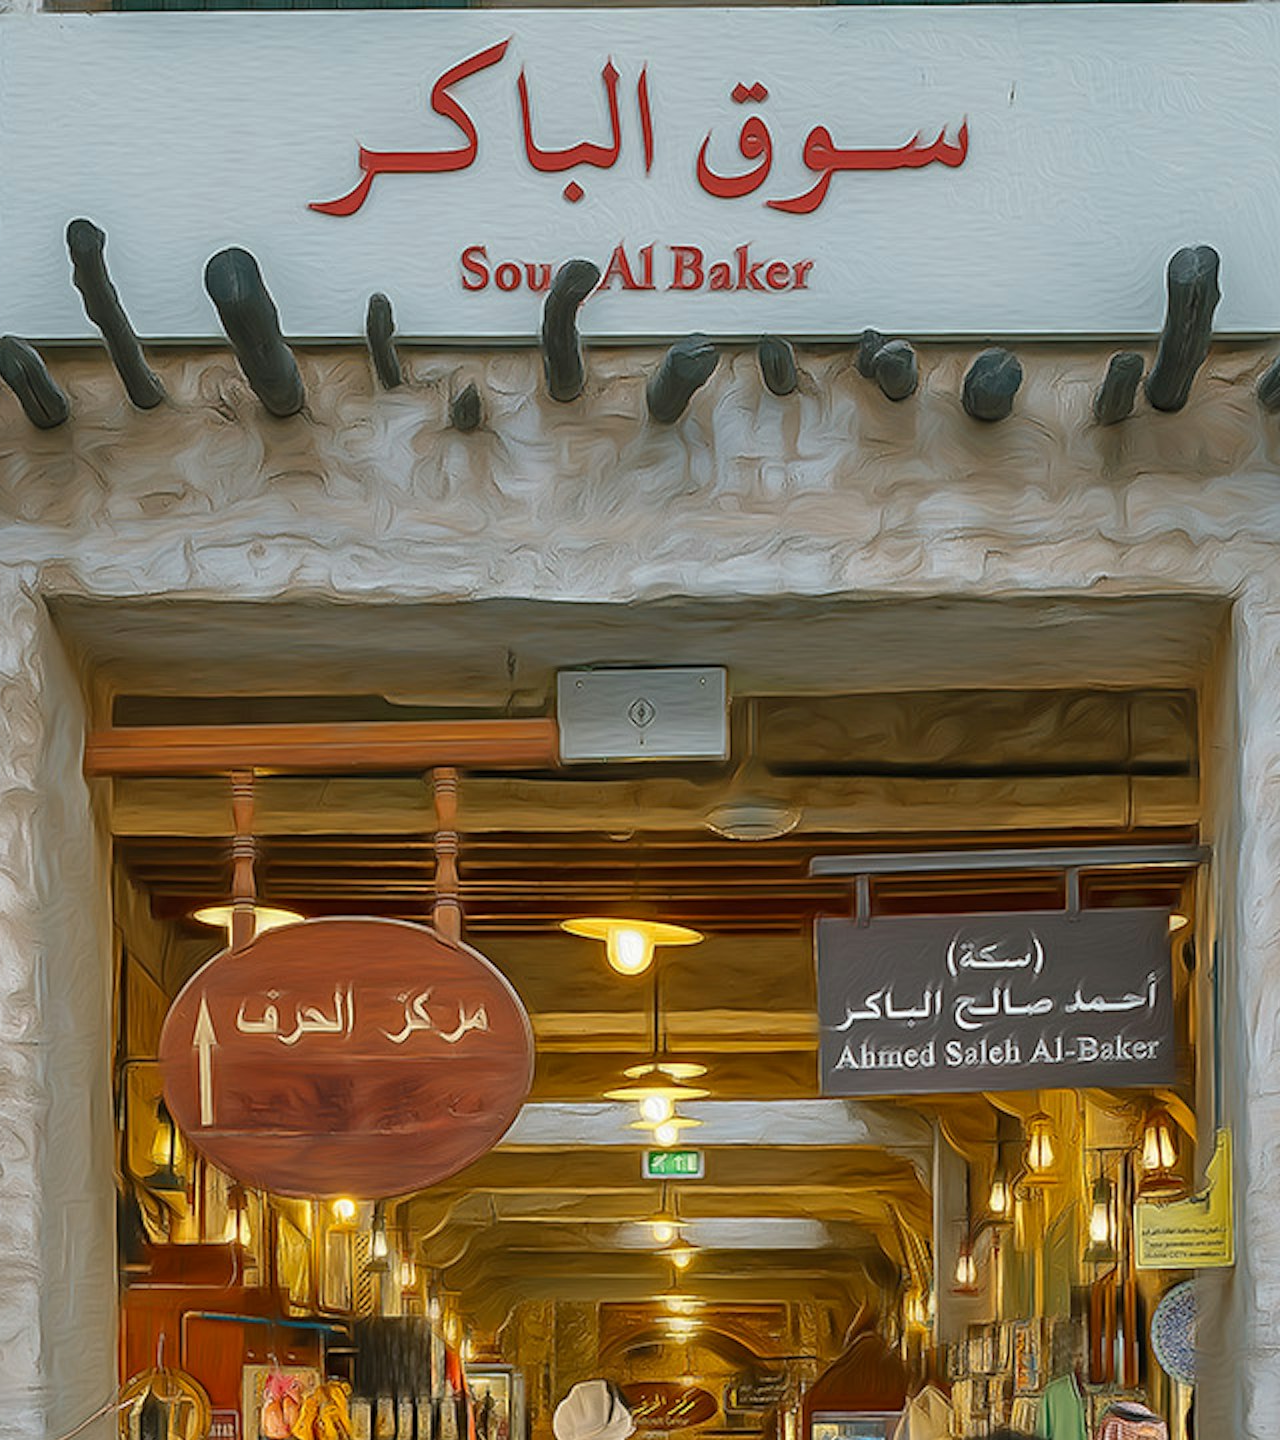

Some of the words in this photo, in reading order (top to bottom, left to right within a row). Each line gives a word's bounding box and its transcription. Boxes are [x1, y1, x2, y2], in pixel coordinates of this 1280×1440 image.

[307, 36, 655, 218] الباكر
[695, 80, 970, 215] سوق
[461, 245, 556, 292] Sou
[597, 241, 657, 291] Al
[668, 242, 814, 291] Baker
[946, 935, 1045, 977] (سكة)
[235, 982, 356, 1047] الحرف
[383, 985, 491, 1045] مركز
[834, 986, 944, 1032] الباكر
[953, 985, 1053, 1031] صالح
[1064, 970, 1160, 1014] أحمد
[834, 1037, 937, 1071] Ahmed
[944, 1036, 1022, 1068] Saleh
[1029, 1034, 1161, 1064] Al-Baker
